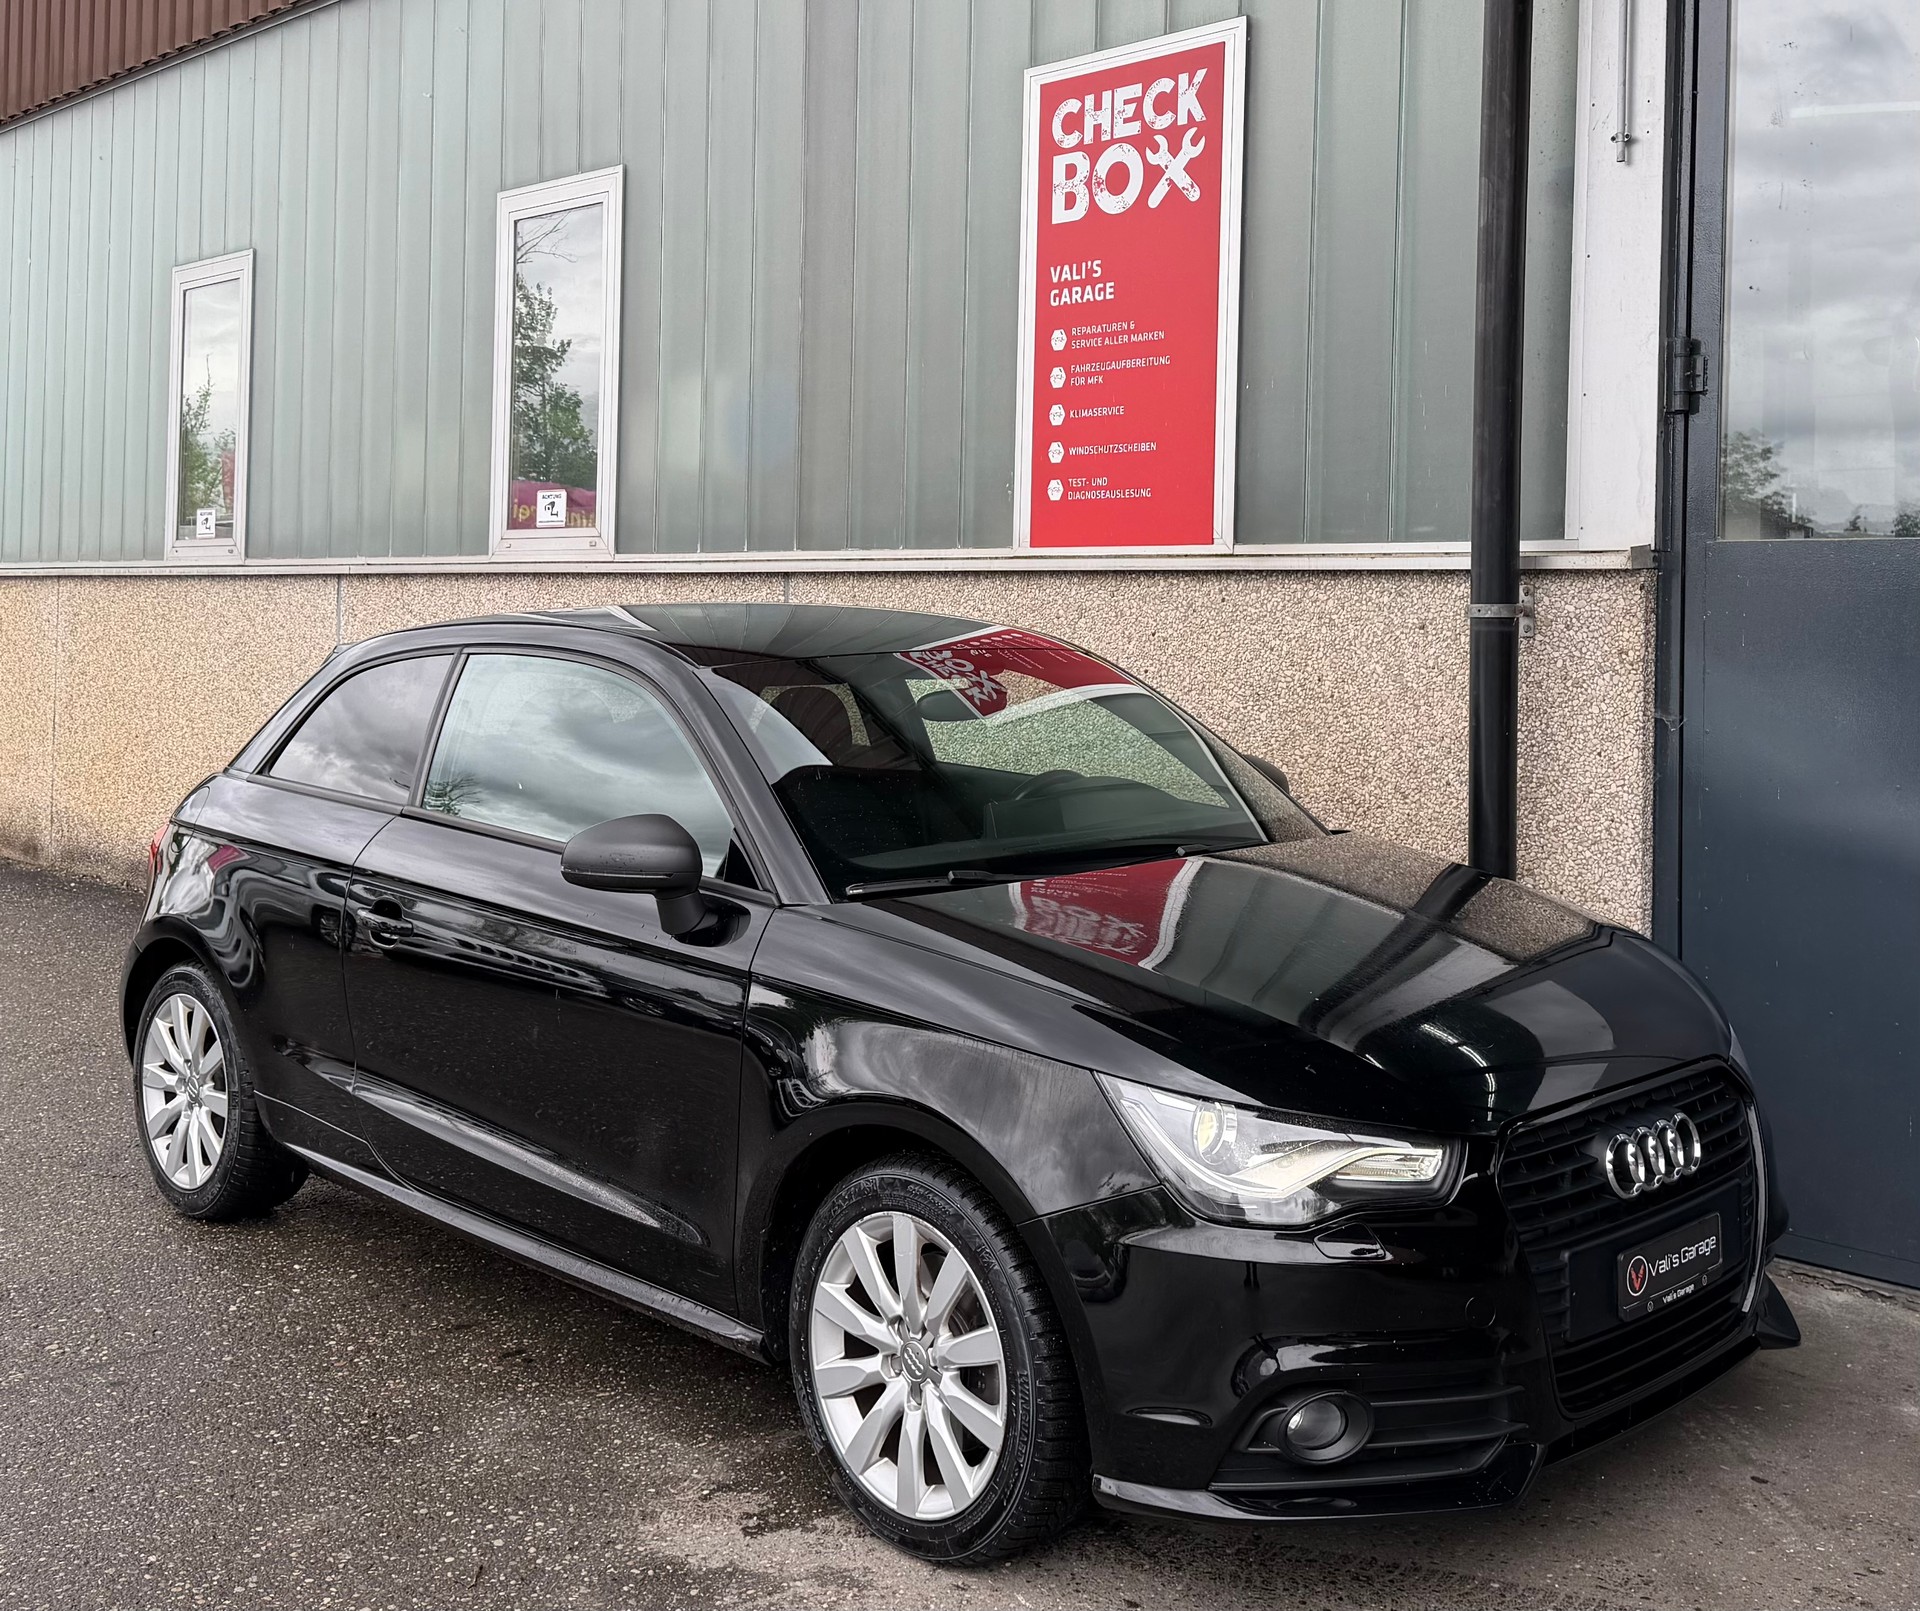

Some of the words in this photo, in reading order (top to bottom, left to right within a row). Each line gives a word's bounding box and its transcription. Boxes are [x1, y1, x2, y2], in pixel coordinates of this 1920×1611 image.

[1052, 68, 1208, 148] CHECK
[1052, 127, 1206, 225] BOX
[1050, 260, 1102, 283] VALI'S
[1050, 282, 1115, 307] GARAGE
[1071, 321, 1128, 336] REPARATUREN
[1129, 320, 1136, 330] &
[1071, 337, 1103, 350] SERVICE
[1104, 335, 1129, 346] ALLER
[1130, 330, 1165, 343] MARKEN
[1070, 355, 1171, 373] FAHRZEUGAUFBEREITUNG
[1087, 375, 1104, 385] MFK
[1069, 406, 1125, 418] KLIMASERVICE
[1068, 442, 1157, 456] WINDSCHUTZSCHEIBEN
[1068, 478, 1090, 487] TEST-
[1091, 477, 1108, 487] UND
[1067, 488, 1152, 501] DIAGNOSEAUSLESUNG
[1649, 1253, 1680, 1277] Vali's
[1680, 1235, 1717, 1263] Garage
